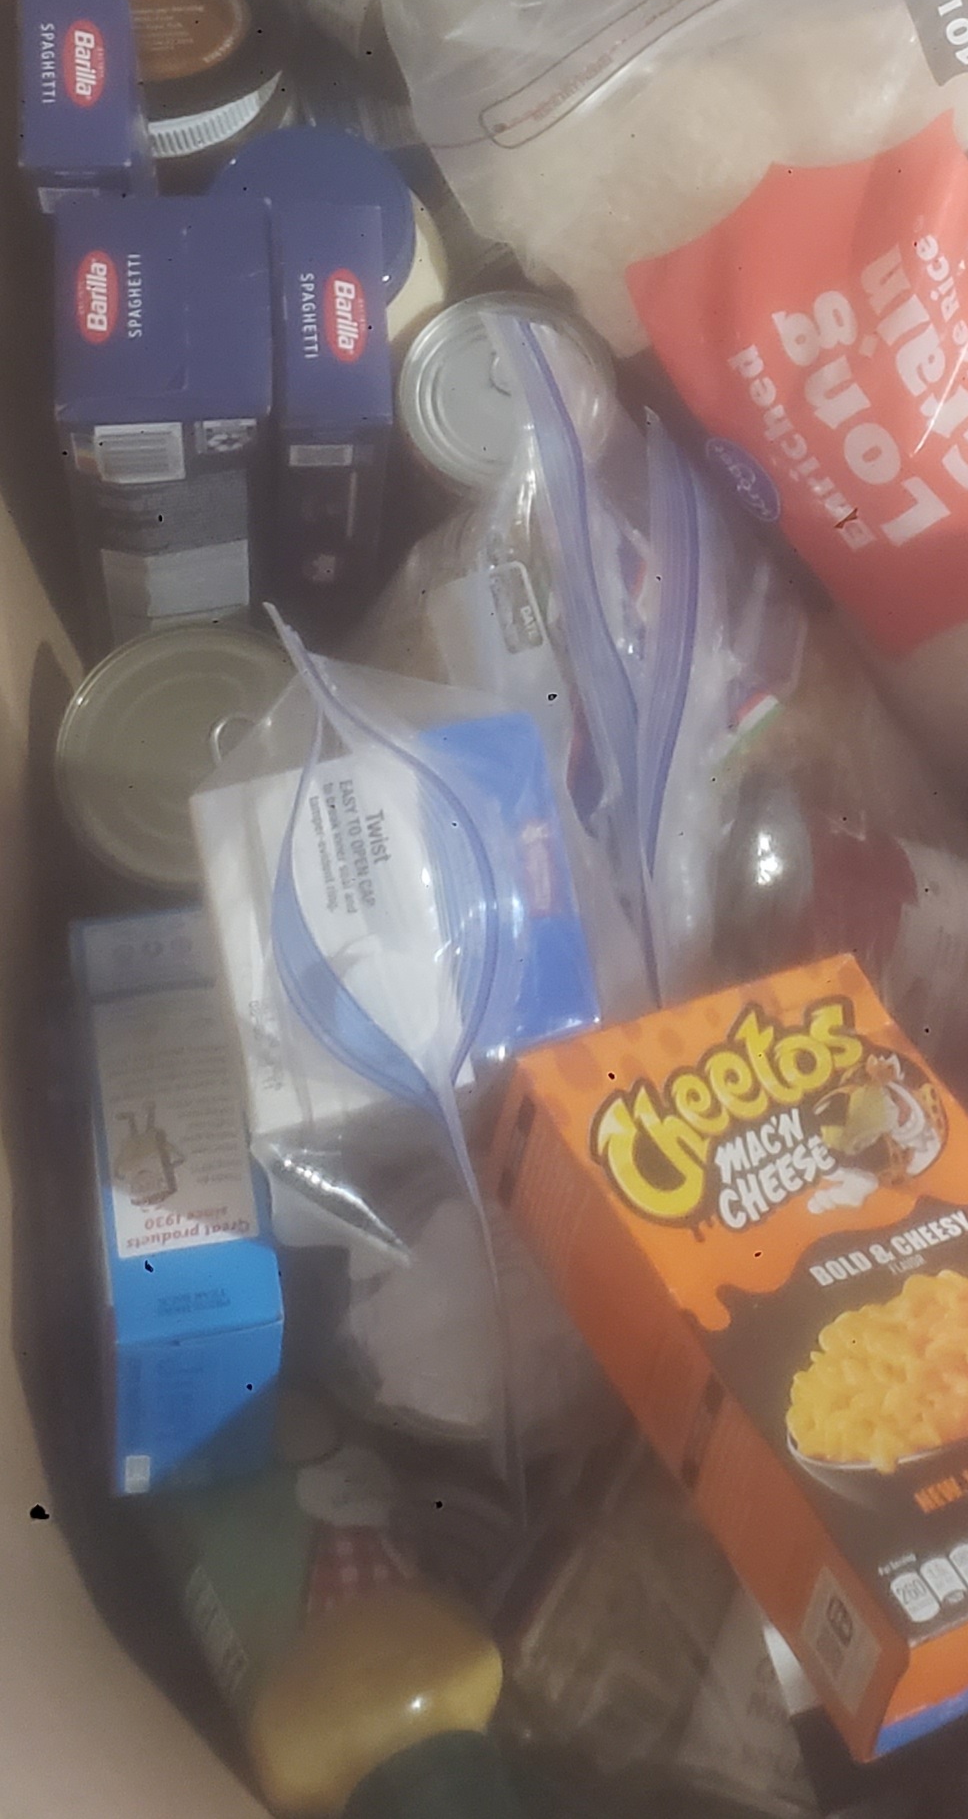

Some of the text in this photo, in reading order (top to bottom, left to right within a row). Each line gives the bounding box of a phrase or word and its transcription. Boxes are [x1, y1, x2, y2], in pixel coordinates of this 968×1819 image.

[40, 23, 56, 104] SPAGHETTI
[74, 30, 97, 97] Barilla
[86, 262, 108, 332] Barilla
[127, 254, 143, 339] SPAGHETTI
[914, 233, 961, 323] Rice
[300, 272, 320, 360] SPAGHETTI
[334, 279, 360, 351] Barilla
[726, 344, 879, 551] Enriched
[770, 289, 952, 548] Long
[338, 779, 358, 814] EASY
[347, 815, 363, 837] TO
[350, 839, 370, 878] OPEN
[365, 808, 392, 865] Twist
[595, 999, 865, 1218] Cheetos
[714, 1107, 805, 1185] MAC'N
[717, 1132, 838, 1231] CHEESE
[125, 1218, 251, 1249] Great products
[143, 1212, 183, 1231] 1930
[809, 1242, 872, 1288] BOLD
[868, 1241, 894, 1267] &
[899, 1579, 928, 1607] 260
